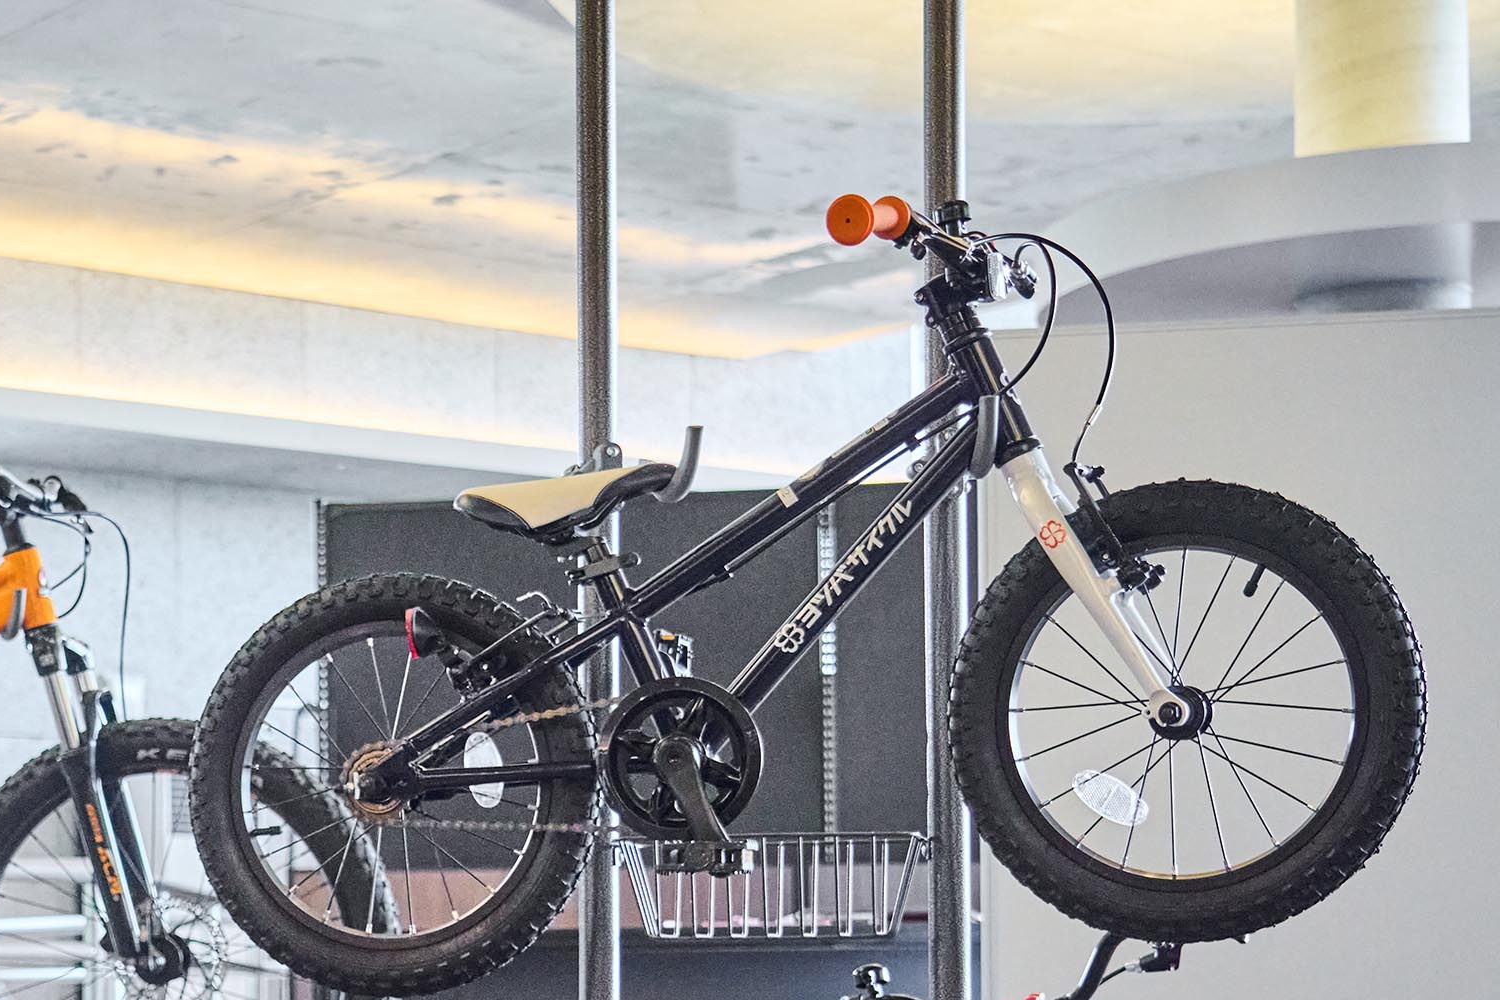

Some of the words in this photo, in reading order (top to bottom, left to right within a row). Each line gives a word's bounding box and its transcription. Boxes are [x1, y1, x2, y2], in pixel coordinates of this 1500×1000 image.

[796, 500, 912, 629] ヨツバサイクル
